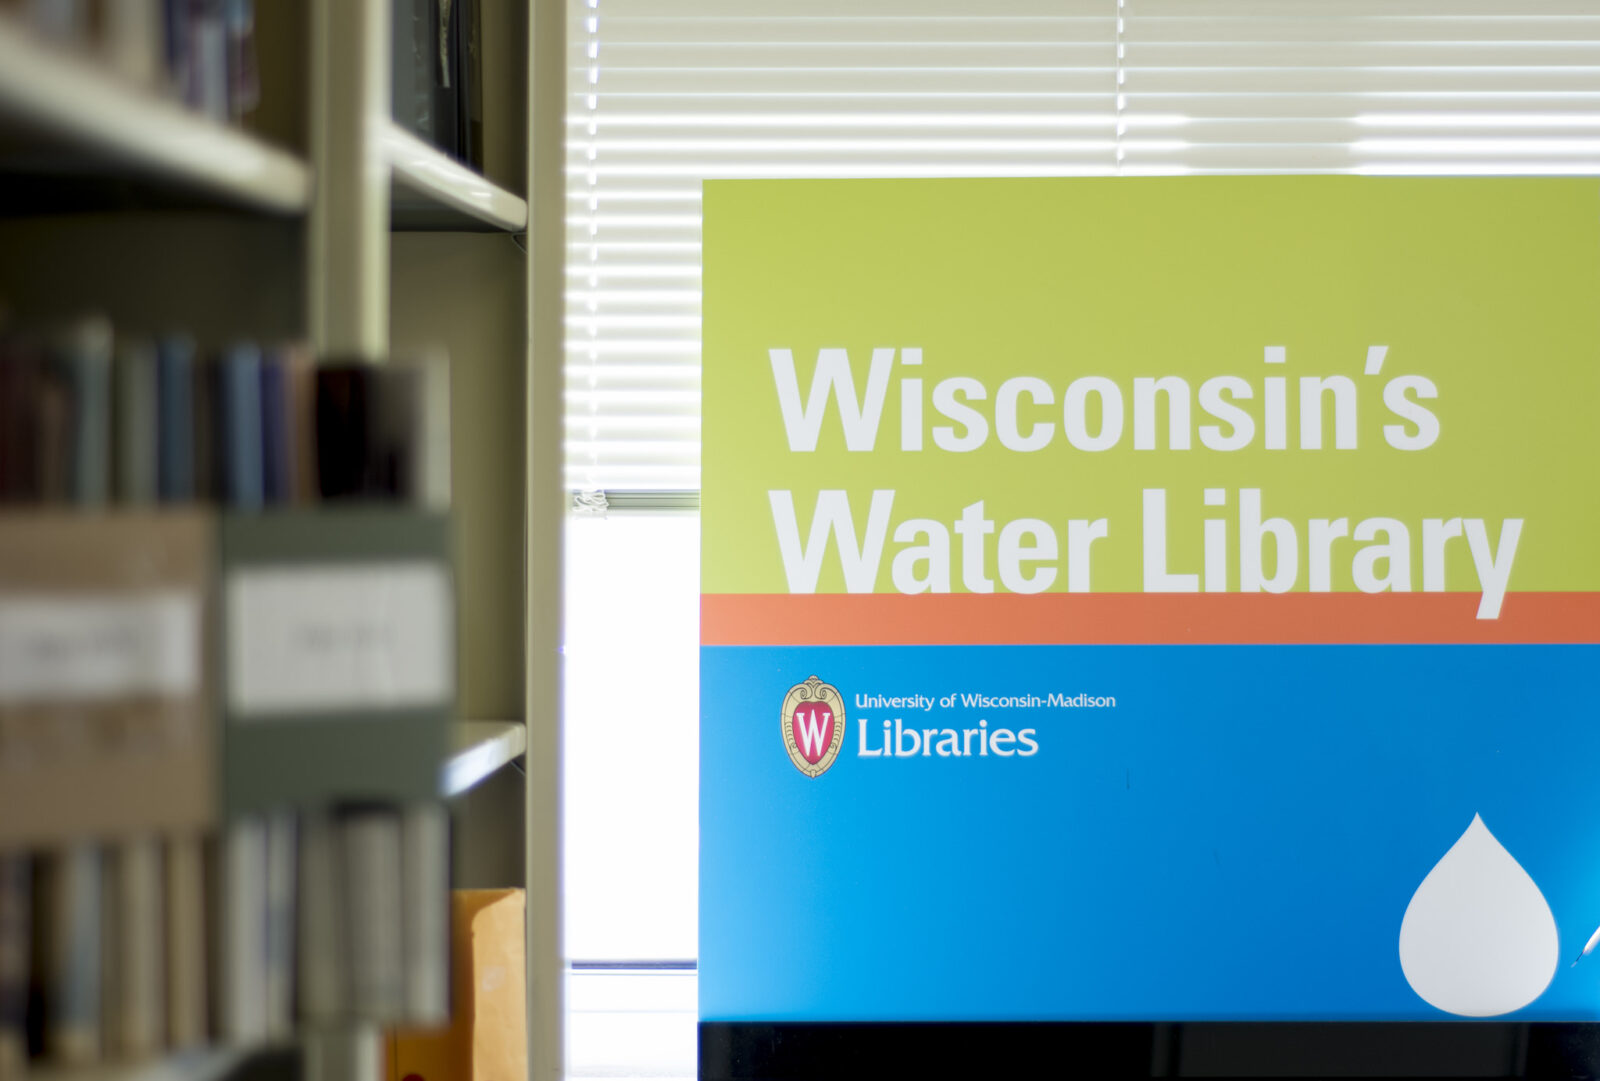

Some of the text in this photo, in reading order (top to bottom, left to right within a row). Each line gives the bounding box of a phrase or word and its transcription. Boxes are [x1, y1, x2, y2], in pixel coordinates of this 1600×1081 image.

[768, 345, 1441, 453] Wisconsin's
[767, 488, 1524, 620] Water Library
[855, 693, 1116, 711] University of Wisconsin-Madison
[796, 709, 830, 757] W
[857, 718, 1039, 757] Libraries
